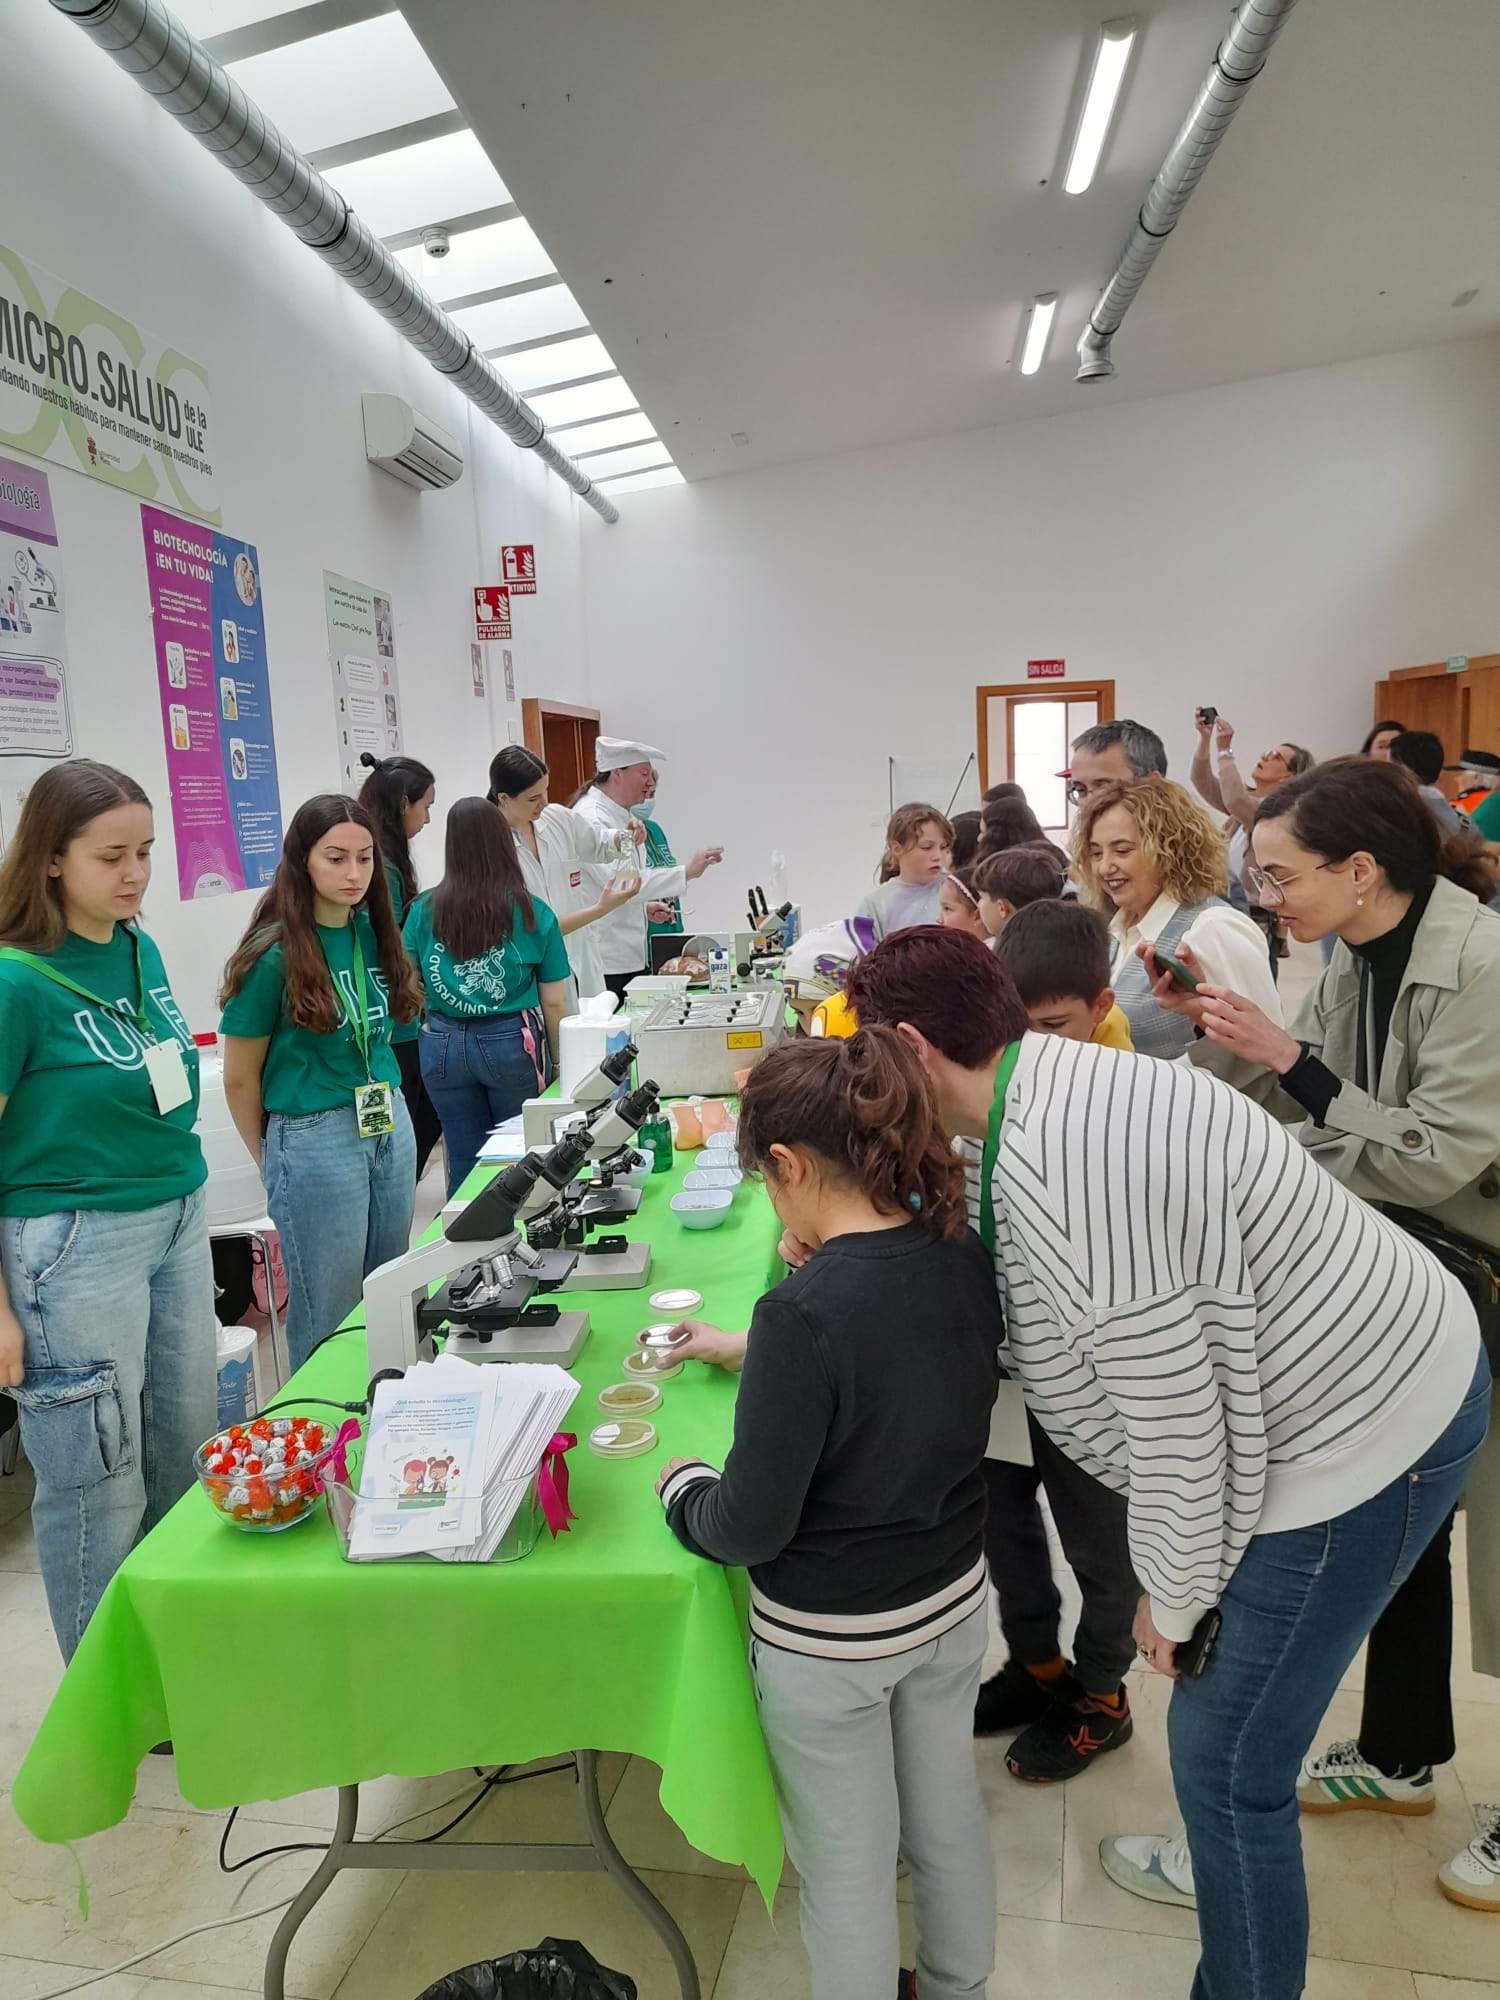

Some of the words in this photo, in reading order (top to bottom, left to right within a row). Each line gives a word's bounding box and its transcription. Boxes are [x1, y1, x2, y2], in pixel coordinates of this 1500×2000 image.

[184, 400, 196, 424] de
[197, 405, 207, 430] la
[32, 382, 69, 410] nuestros
[100, 414, 117, 432] para
[118, 423, 152, 448] mantener
[153, 439, 173, 459] sanos
[173, 449, 199, 470] nuestros
[199, 460, 213, 476] pies
[185, 425, 205, 453] ULE
[153, 529, 228, 568] BIOTECNOLOGÍA
[174, 557, 187, 575] TU
[188, 562, 214, 584] VIDA!
[479, 625, 510, 633] PULSADOR
[488, 631, 511, 639] ALARMA
[1040, 663, 1063, 675] SALIDA
[340, 697, 345, 712] 2
[711, 963, 728, 972] gaza
[429, 955, 487, 1014] UNIVERSIDAD
